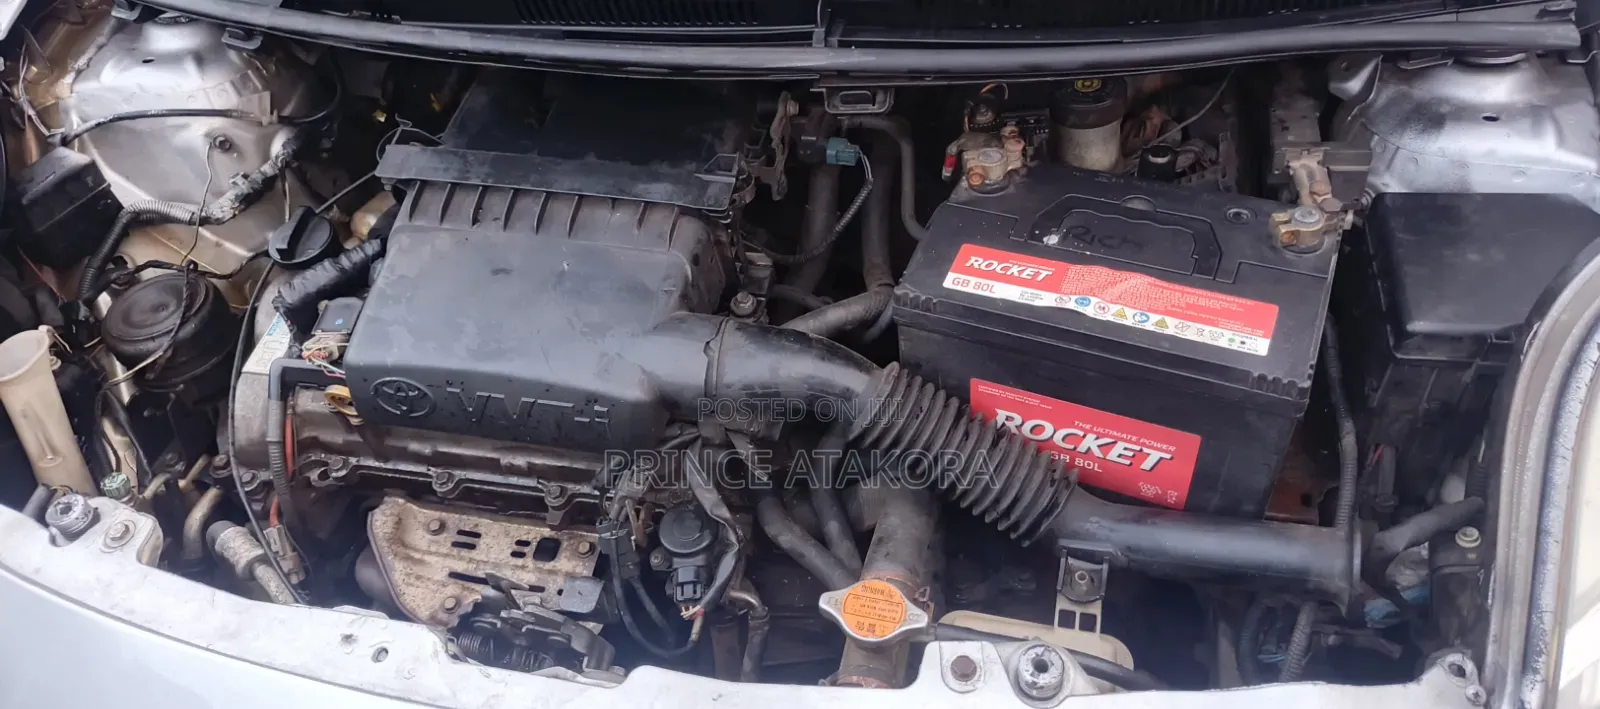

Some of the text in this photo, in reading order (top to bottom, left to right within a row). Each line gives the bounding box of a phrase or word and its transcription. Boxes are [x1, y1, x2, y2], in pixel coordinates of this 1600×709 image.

[965, 256, 1053, 281] ROCKET
[951, 277, 996, 294] GB 80L
[994, 408, 1172, 471] ROCKET
[1074, 420, 1176, 452] THE ULTIMATE POWER
[1050, 451, 1104, 473] GB 80L
